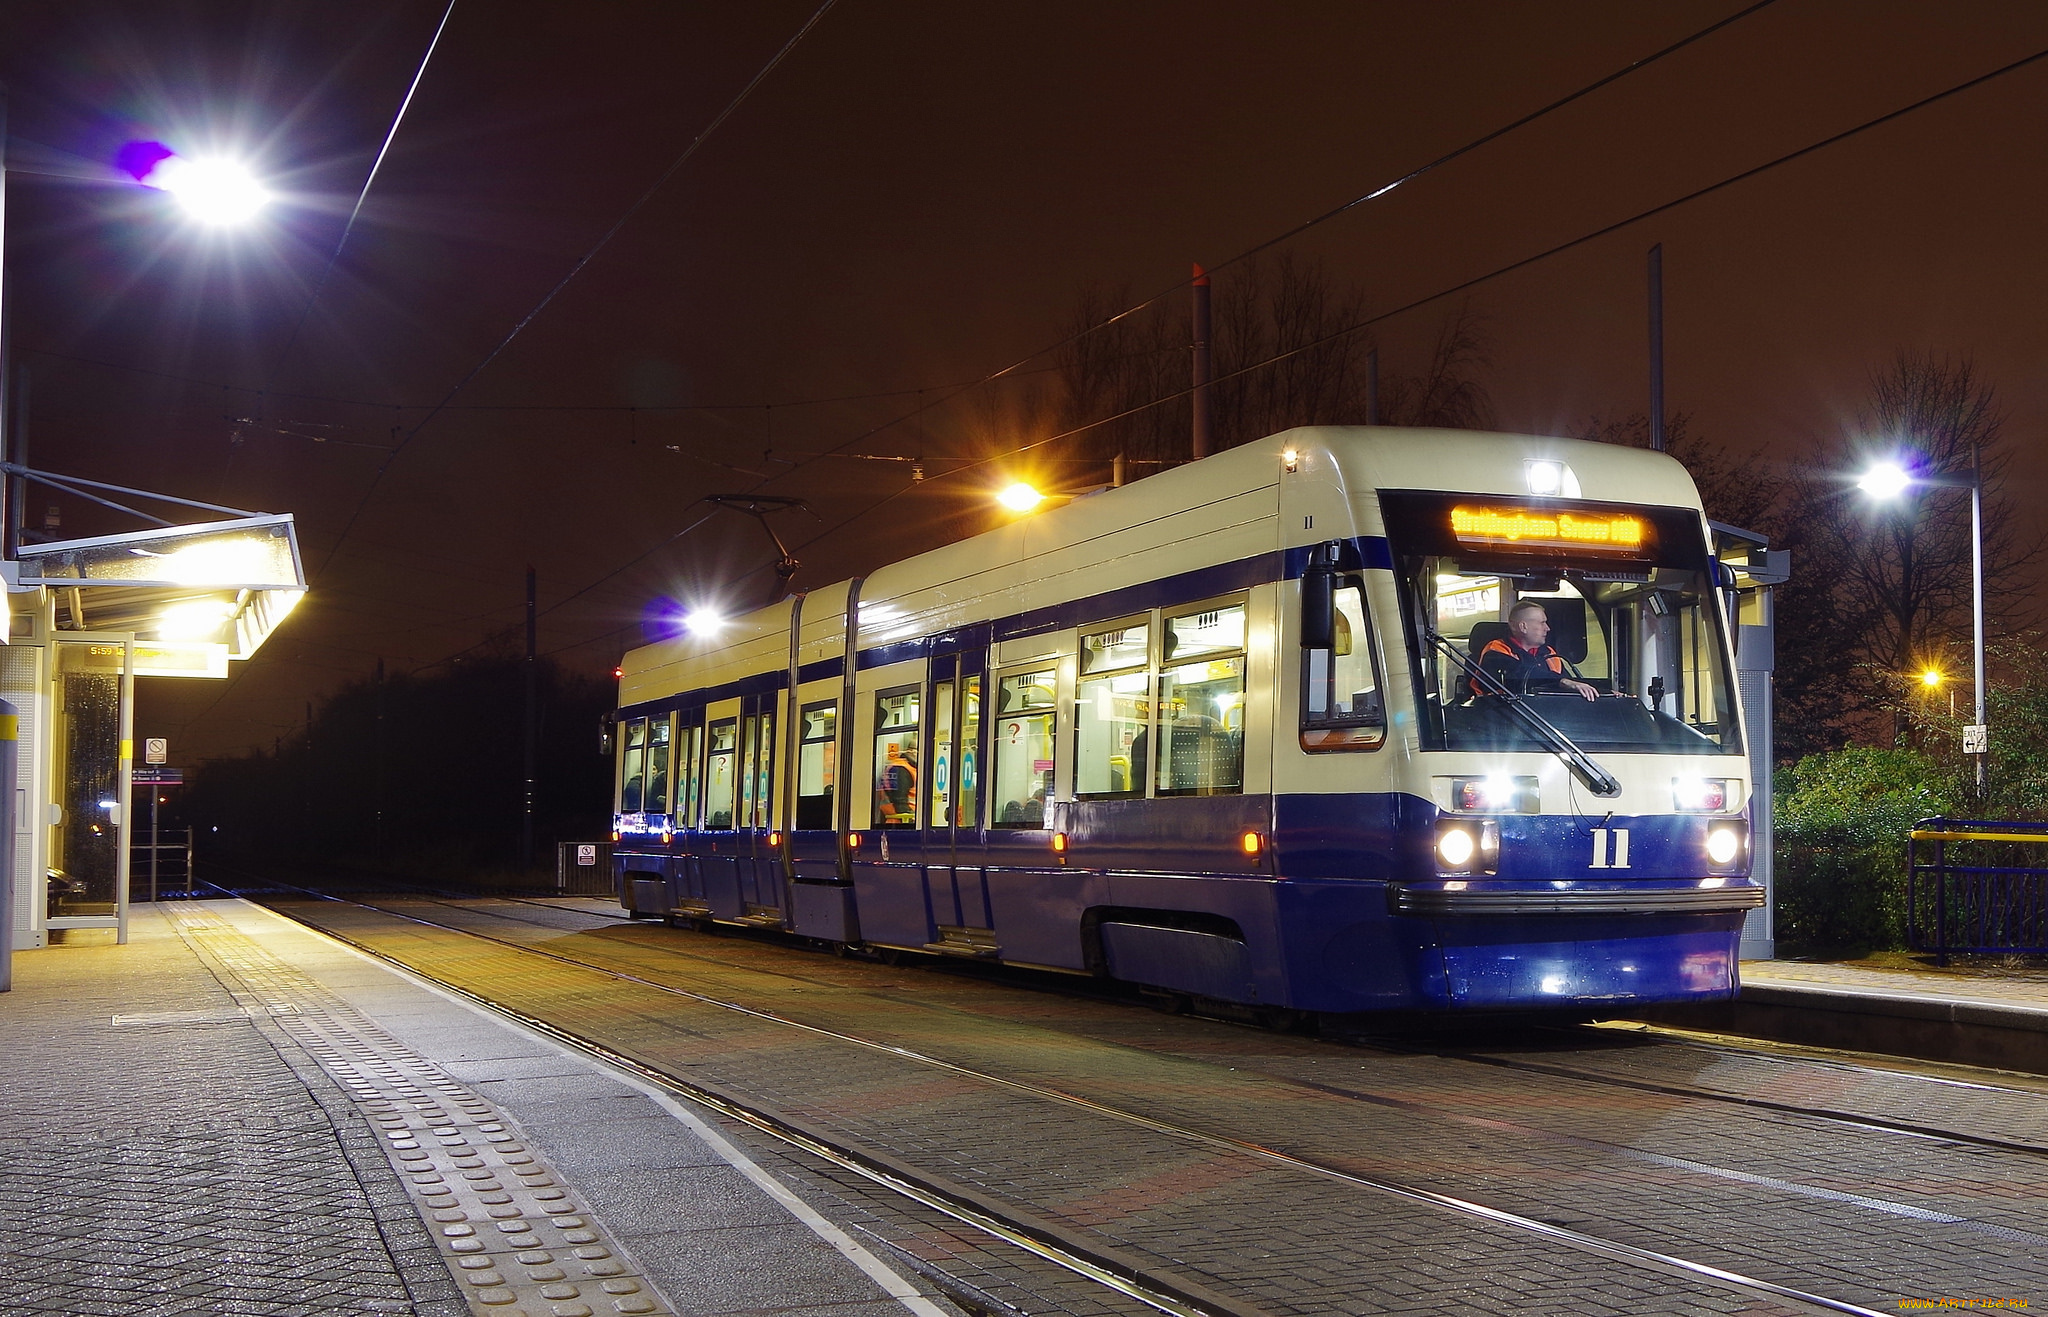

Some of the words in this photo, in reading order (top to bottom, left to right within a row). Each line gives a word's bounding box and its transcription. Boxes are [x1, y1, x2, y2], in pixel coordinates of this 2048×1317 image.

[1304, 515, 1313, 529] 11
[1559, 514, 1609, 540] Snow
[90, 646, 112, 656] 5:59
[1964, 730, 1976, 738] EXIT
[1588, 828, 1632, 869] 11
